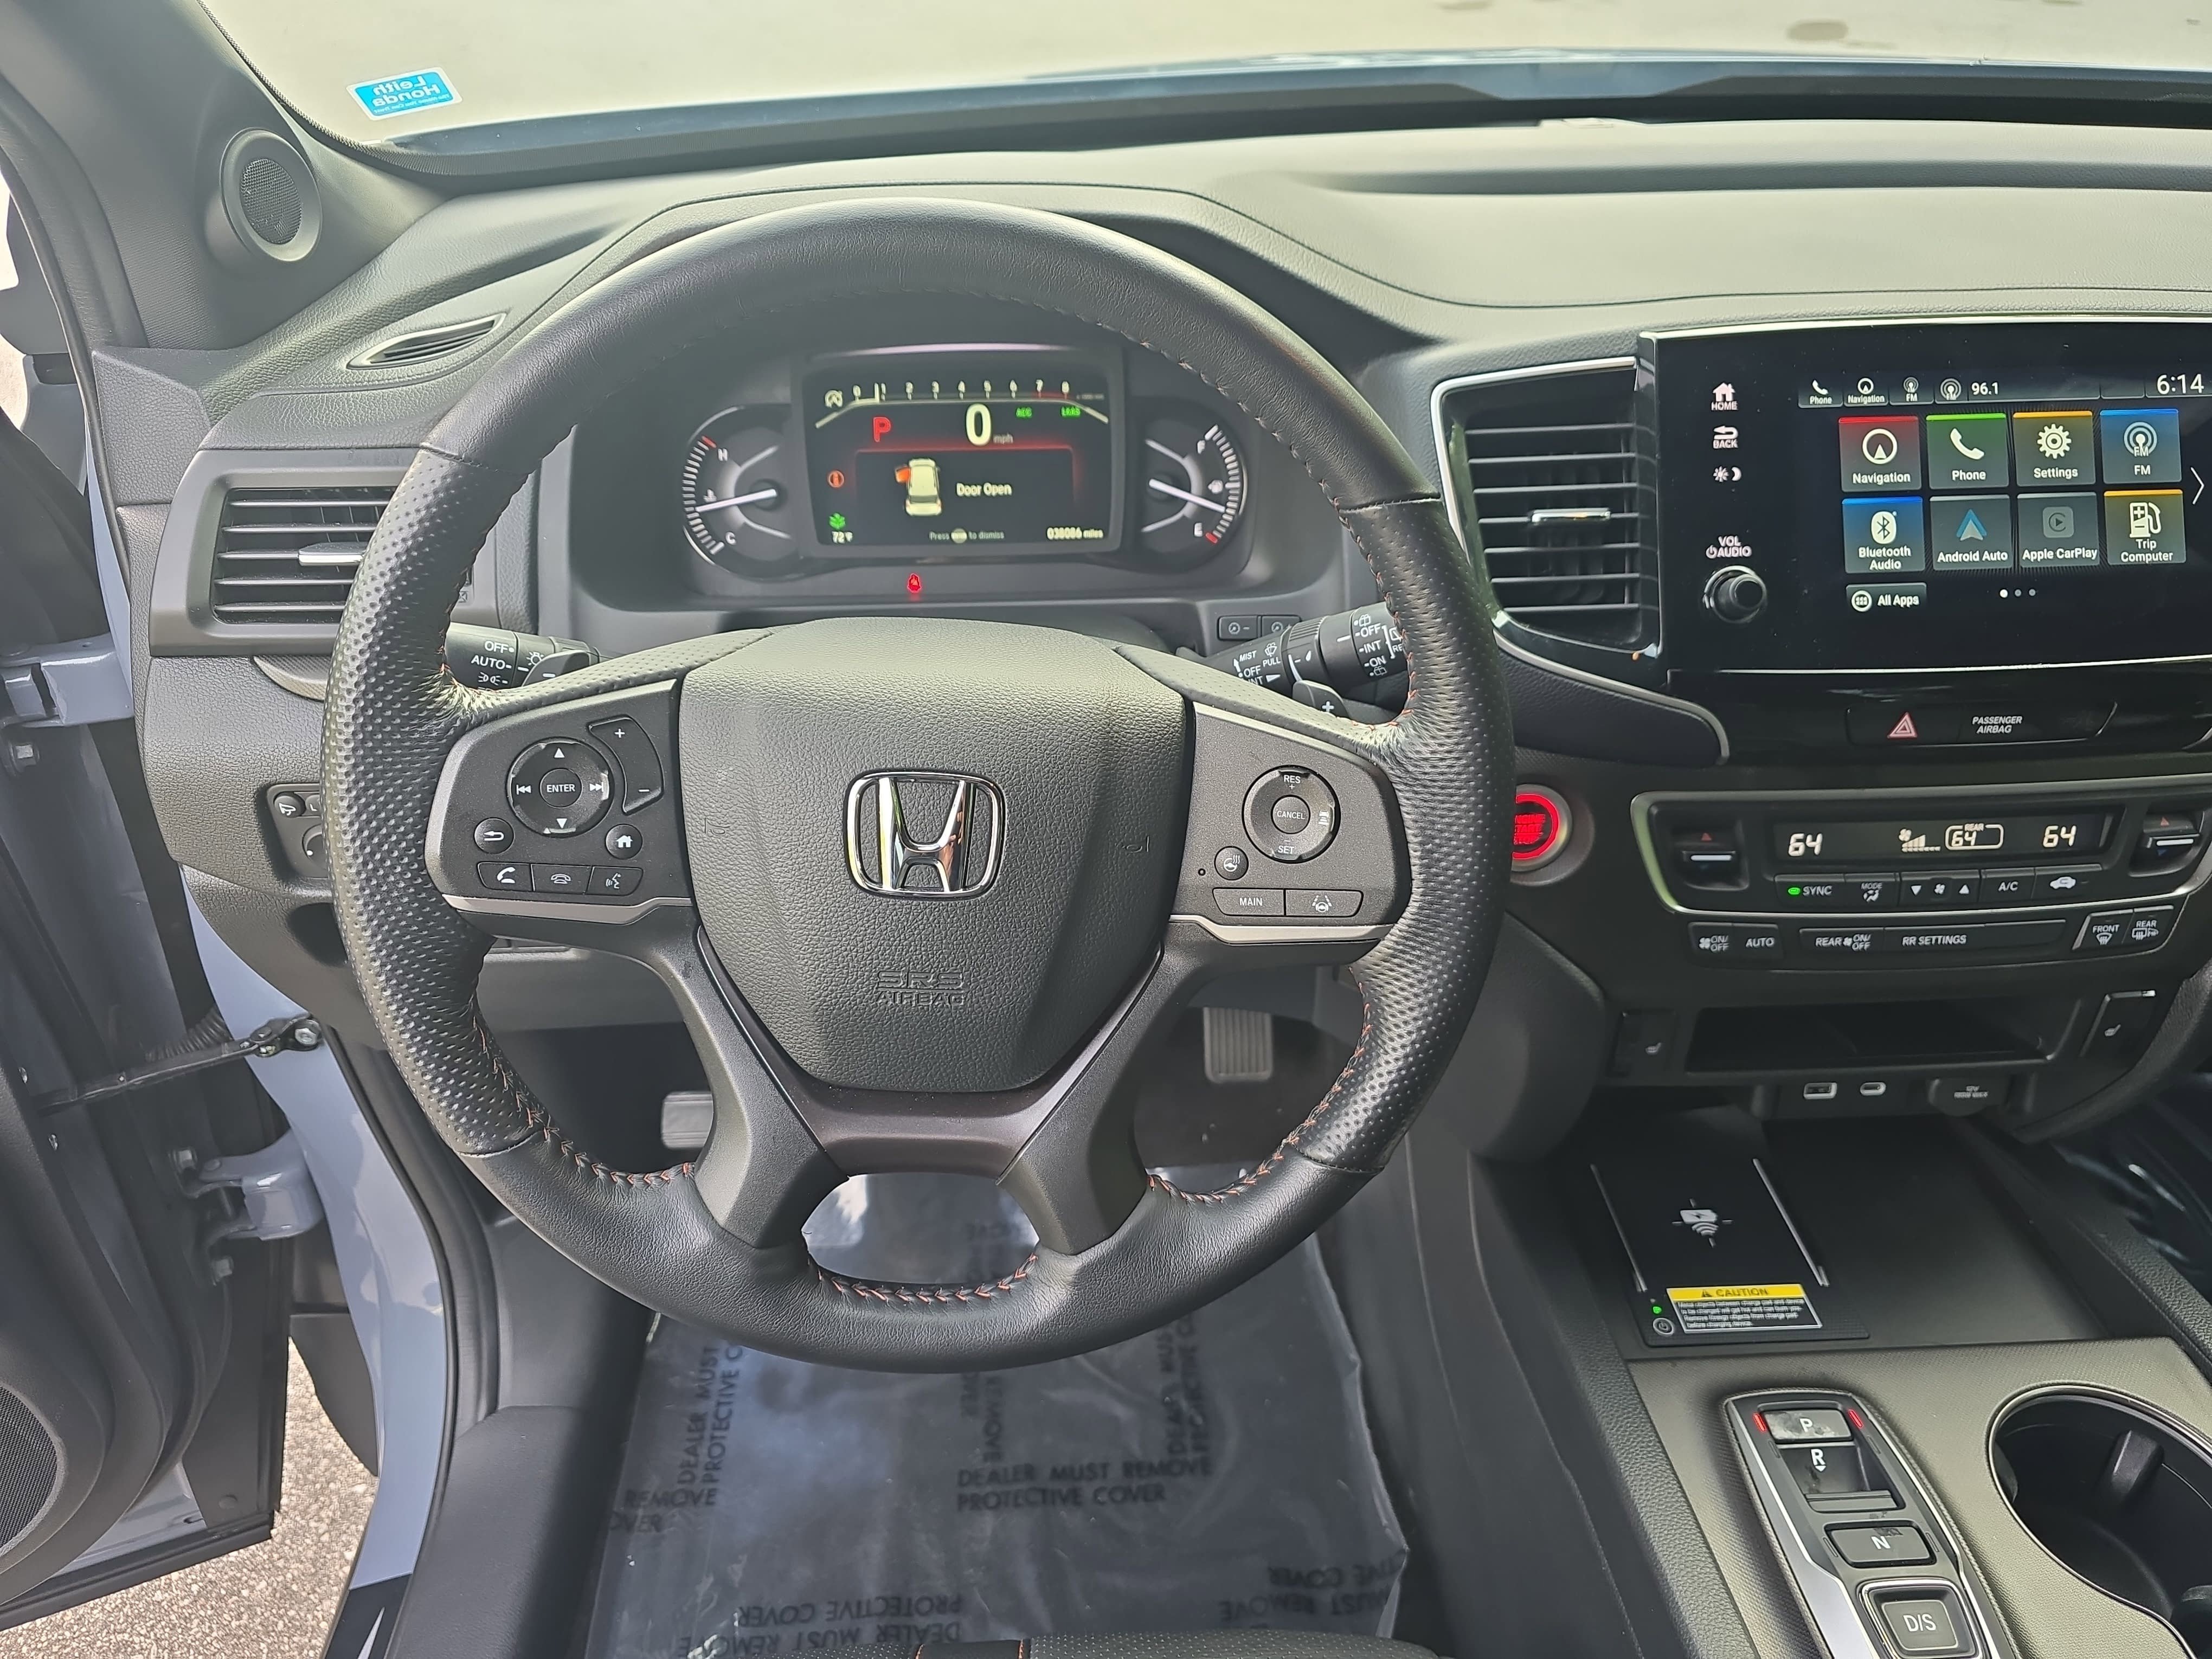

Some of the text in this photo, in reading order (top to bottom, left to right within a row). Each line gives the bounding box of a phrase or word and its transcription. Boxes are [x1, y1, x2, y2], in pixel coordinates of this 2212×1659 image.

[1971, 382, 1998, 395] 96.1
[2157, 374, 2204, 395] 6:14
[1810, 396, 1832, 405] Phone
[1848, 395, 1885, 404] Navigation
[1906, 393, 1918, 402] FM
[1711, 401, 1738, 411] HOME
[873, 416, 891, 442] P
[966, 403, 1014, 446] 0 mph
[1713, 439, 1739, 449] BACK
[1951, 469, 1987, 481] Phone
[2033, 467, 2079, 480] Settings
[2134, 465, 2151, 475] FM
[1852, 471, 1911, 485] Navigation
[956, 482, 1012, 497] Door Open
[1718, 535, 1741, 547] VOL
[2136, 538, 2157, 551] Trip
[1717, 545, 1752, 558] AUDIO
[1858, 545, 1912, 558] Bluetooth
[1937, 550, 2009, 563] Android Auto
[2022, 547, 2098, 562] Apple CarPlay
[2121, 551, 2174, 564] Computer
[1869, 558, 1902, 571] Audio
[1877, 594, 1920, 608] All Apps
[1360, 623, 1381, 638] OFF
[484, 640, 509, 654] OFF
[1363, 641, 1382, 654] INT
[471, 654, 505, 670] AUTO
[1239, 650, 1257, 662] MIST
[1263, 655, 1281, 667] PULL
[1369, 654, 1387, 667] ON
[1243, 664, 1262, 678] OFF
[1972, 715, 2023, 725] PASSENGER
[1976, 725, 2012, 734] AIRBAG
[1283, 774, 1301, 784] RES
[546, 783, 576, 793] ENTER
[1277, 810, 1306, 820] CANCEL
[1951, 831, 1978, 847] 64
[2042, 825, 2077, 848] 64
[1277, 846, 1295, 854] SET
[1789, 833, 1823, 857] 64
[1802, 885, 1833, 896] SYNC
[1861, 882, 1883, 890] MODE
[1998, 881, 2018, 892] A/C
[1239, 897, 1263, 906] MAIN
[2092, 924, 2120, 934] FRONT
[2136, 919, 2157, 929] REAR
[1745, 937, 1775, 948] AUTO
[1815, 937, 1842, 947] REAR
[1852, 941, 1871, 951] OFF
[1902, 934, 1967, 946] RR SETTINGS
[1710, 943, 1729, 952] OFF
[877, 970, 964, 989] SRS
[876, 991, 964, 1007] AIRBAG
[1716, 1288, 1768, 1297] CAUTION
[678, 1347, 721, 1485] DEALER MUST
[702, 1369, 740, 1484] PROTECTIVE
[1799, 1417, 1813, 1432] P
[1811, 1449, 1825, 1465] R
[958, 1456, 1213, 1487] DEALER MUST REMOVE
[626, 1488, 718, 1508] REMOVE
[957, 1483, 1167, 1512] PROTECTIVE COVER
[1870, 1536, 1891, 1550] N
[739, 1594, 962, 1626] PROTECTIVE COVER
[1903, 1613, 1937, 1633] D/S
[792, 1628, 860, 1651] MUST
[876, 1622, 960, 1644] DEALER
